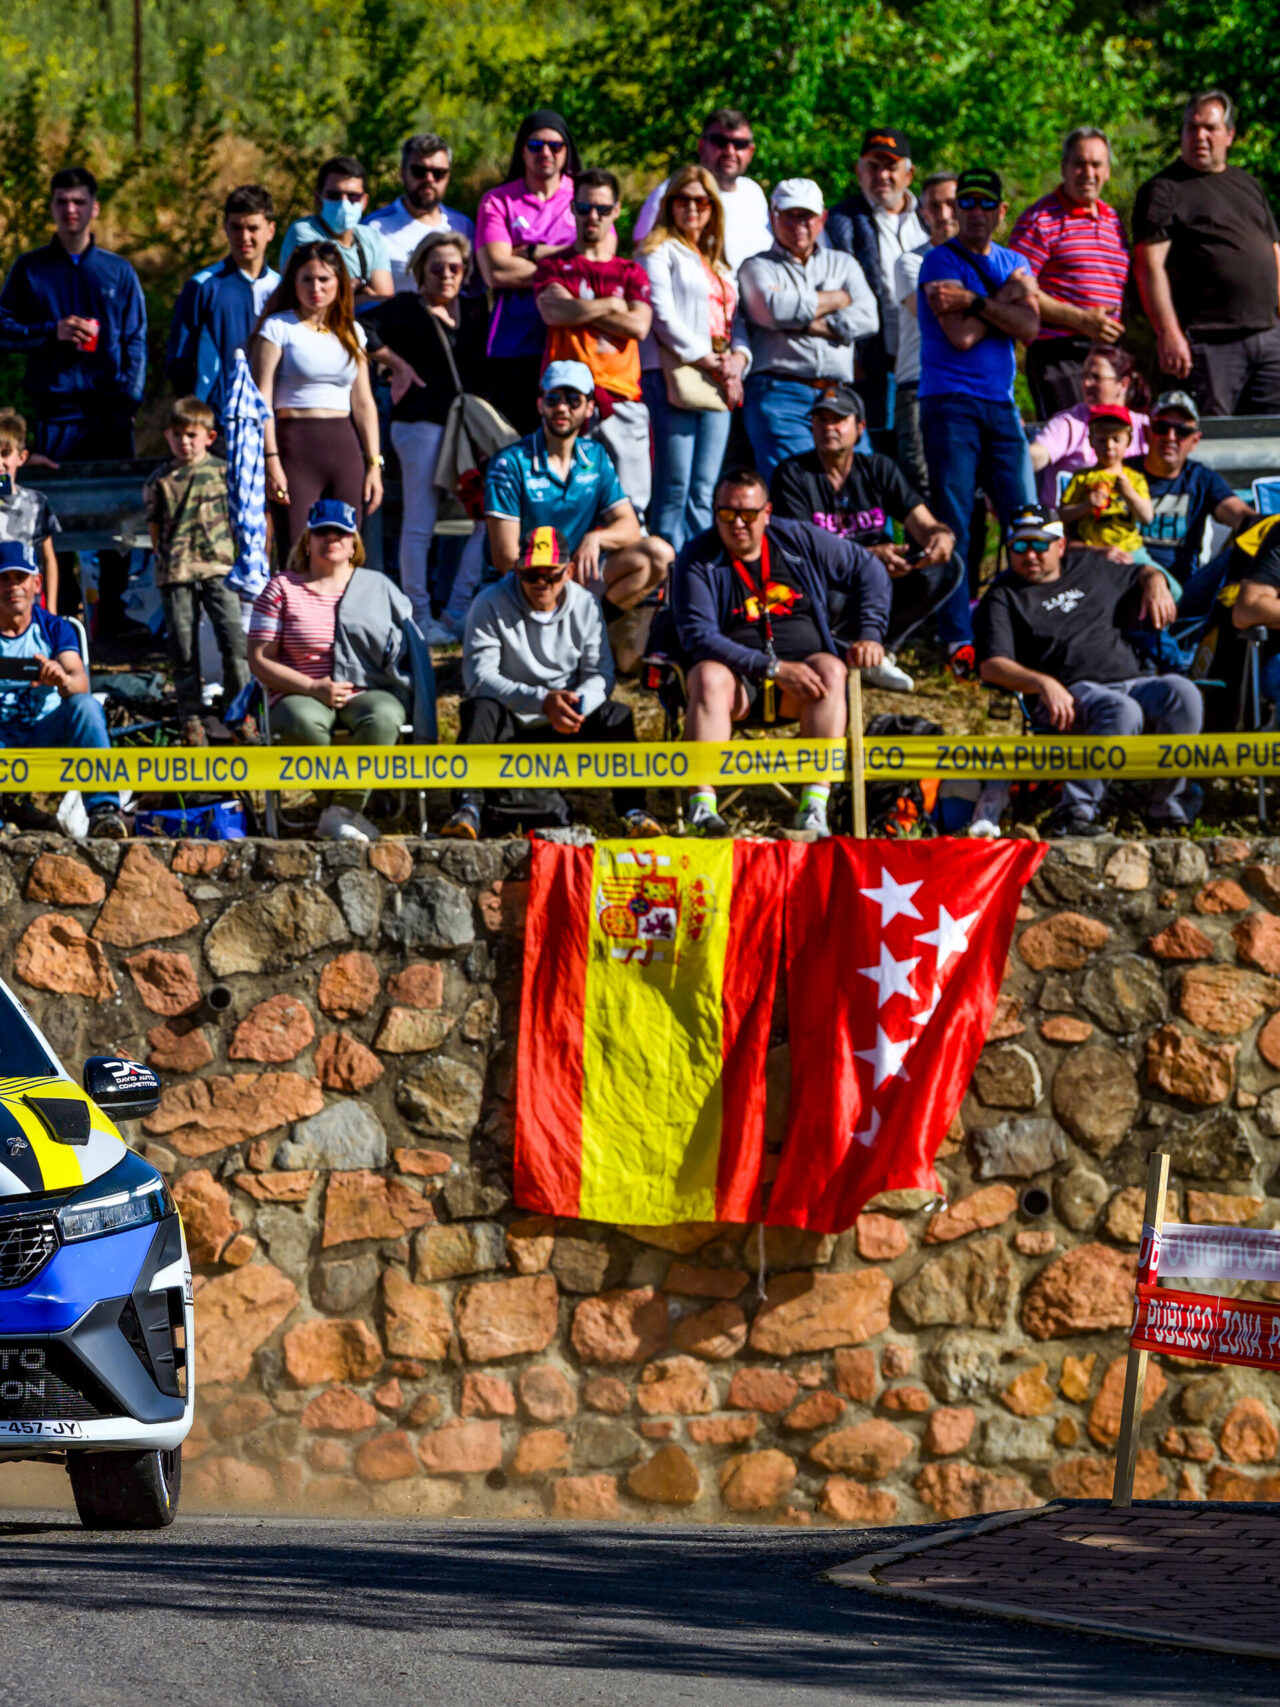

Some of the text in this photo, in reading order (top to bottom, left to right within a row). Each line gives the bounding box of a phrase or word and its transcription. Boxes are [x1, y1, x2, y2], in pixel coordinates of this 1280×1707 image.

[279, 754, 468, 781] ZONA PUBLICO
[499, 752, 688, 779] ZONA PUBLICO
[720, 749, 789, 775] ZONA
[936, 745, 1126, 770] ZONA PUBLICO
[1157, 743, 1229, 768] ZONA
[60, 756, 248, 783] ZONA PUBLICO
[115, 1076, 137, 1084] DAVID
[1145, 1298, 1214, 1351] PUBLICO
[1219, 1310, 1263, 1359] ZONA
